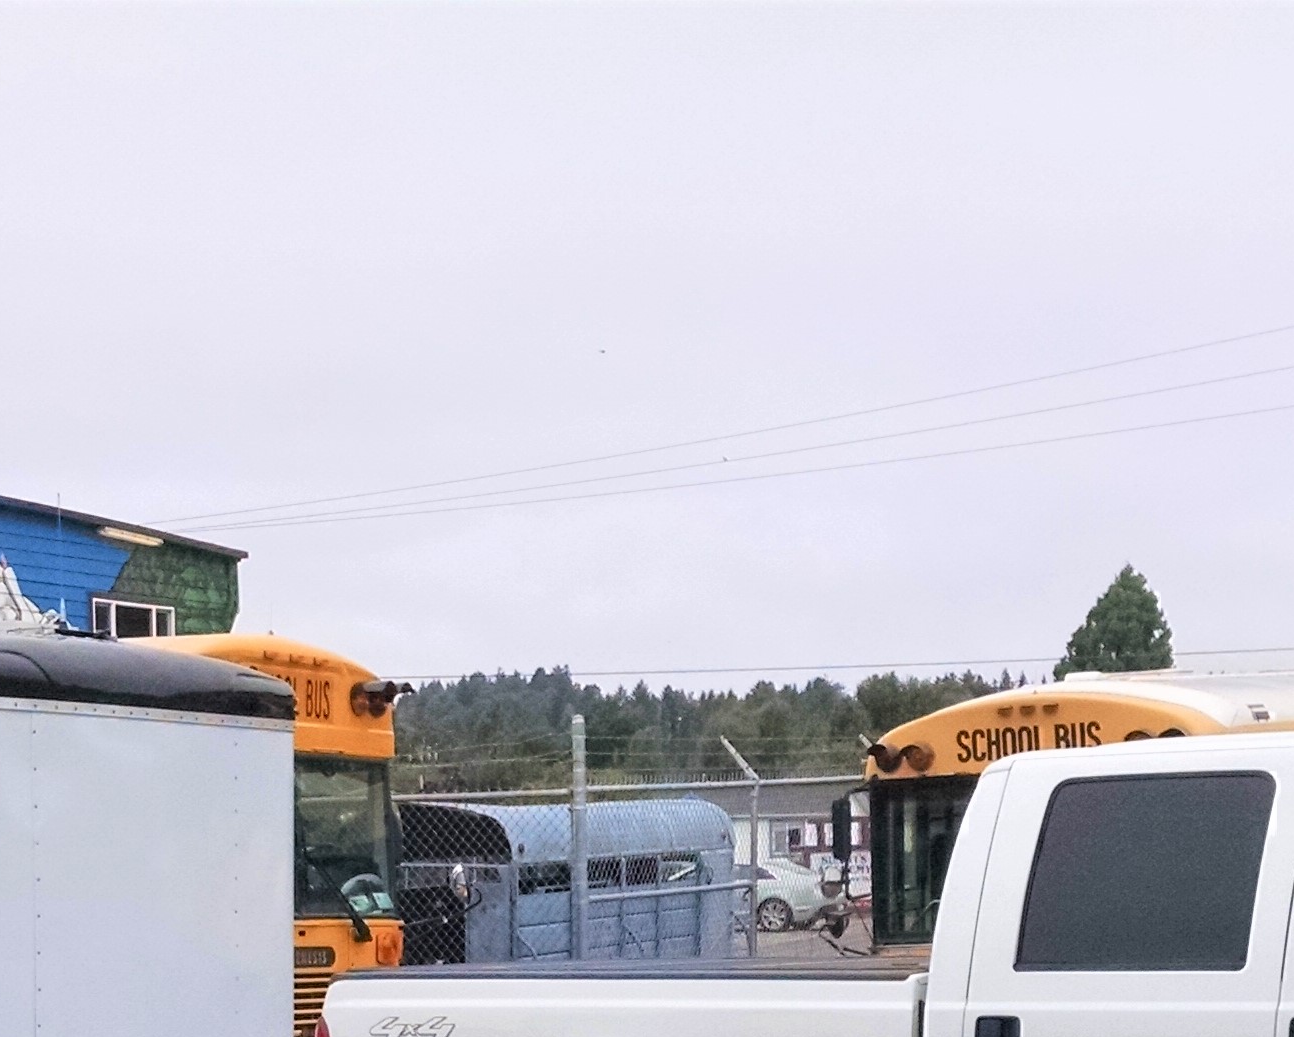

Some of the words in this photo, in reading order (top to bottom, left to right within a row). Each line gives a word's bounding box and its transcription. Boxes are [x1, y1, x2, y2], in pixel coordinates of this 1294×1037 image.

[305, 679, 330, 720] BUS
[956, 725, 1040, 763] SCHOOL
[1054, 721, 1102, 749] BUS
